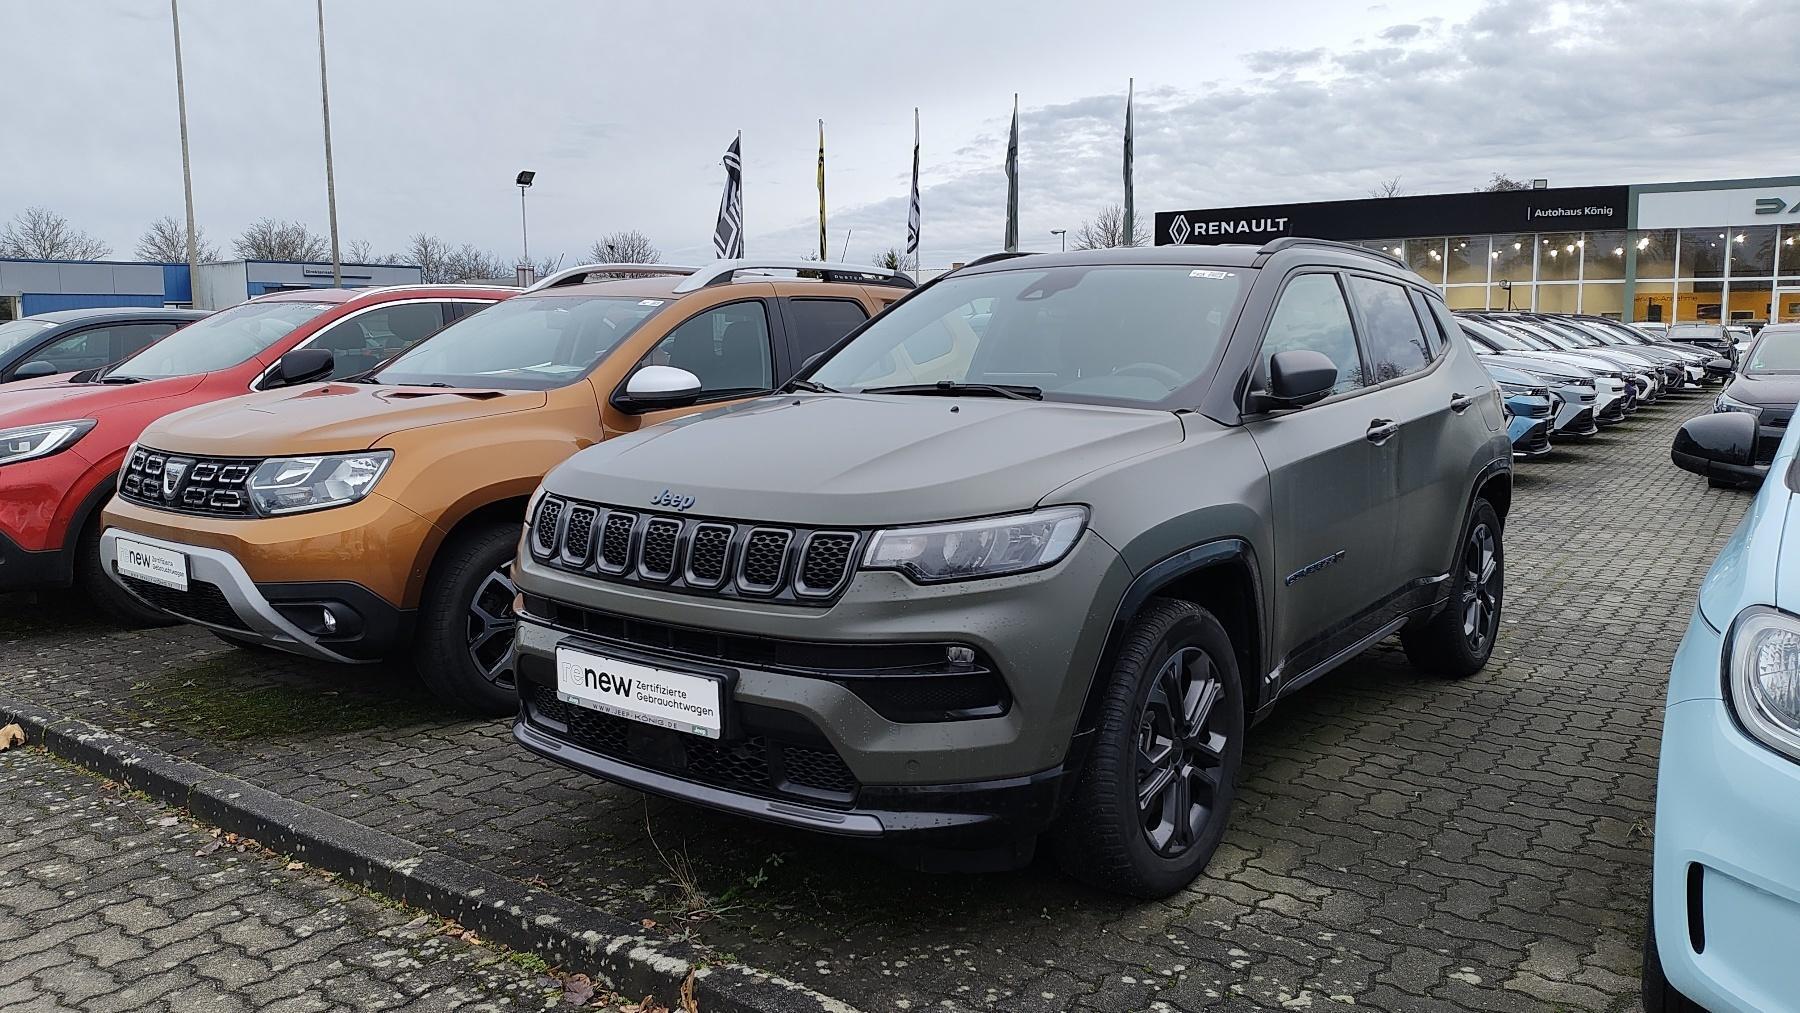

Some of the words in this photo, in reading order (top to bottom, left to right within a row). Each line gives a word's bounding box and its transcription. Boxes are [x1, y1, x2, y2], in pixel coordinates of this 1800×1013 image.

[1534, 208, 1582, 217] Autohaus
[1584, 206, 1613, 216] König
[1194, 218, 1288, 236] RENAULT
[649, 488, 696, 511] Jeep
[562, 661, 632, 698] renew
[636, 680, 687, 699] Zertifizierte
[636, 692, 714, 717] Gebrauchtwagen
